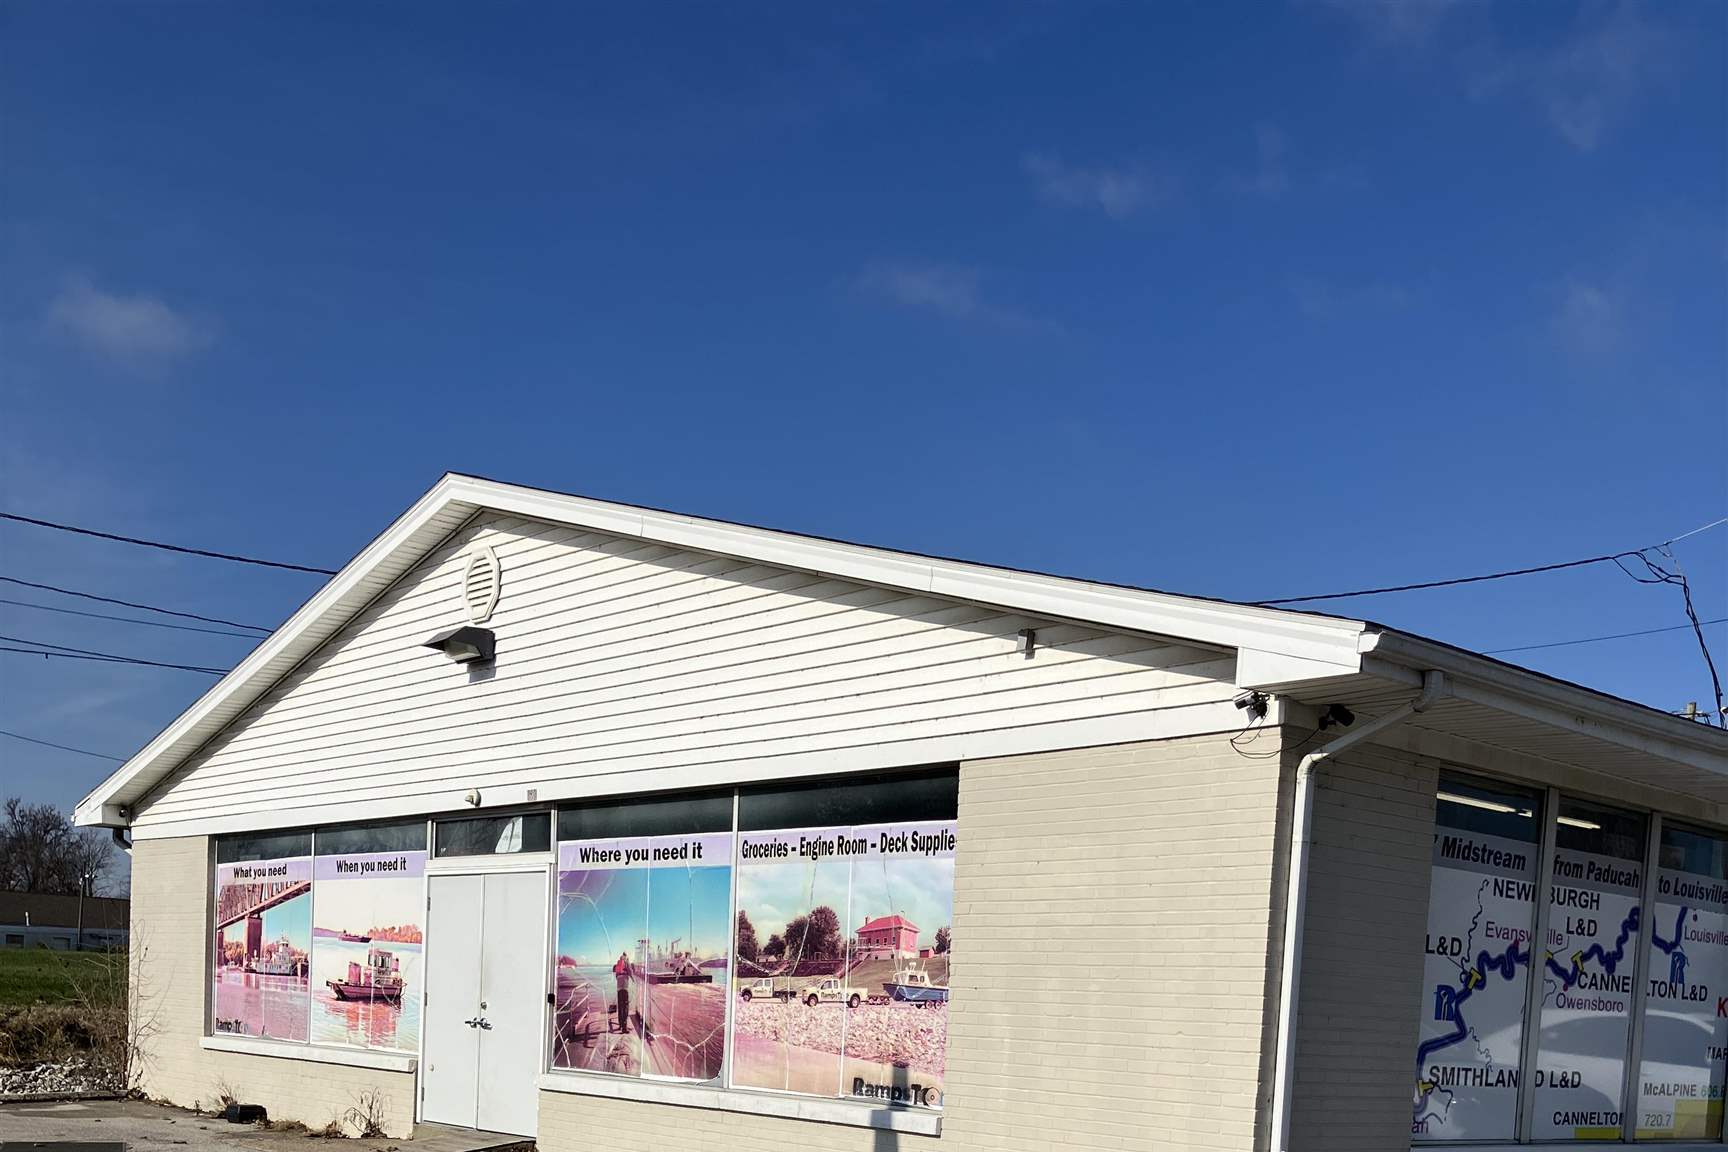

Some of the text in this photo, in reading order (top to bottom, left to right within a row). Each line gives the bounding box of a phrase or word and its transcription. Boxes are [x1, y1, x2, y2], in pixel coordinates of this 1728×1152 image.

[579, 842, 703, 866] Where you need it
[742, 837, 788, 859] Groceries
[799, 835, 834, 860] Engine
[837, 835, 867, 855] Room
[880, 831, 908, 853] Deck
[911, 828, 957, 856] Supplie
[233, 863, 287, 880] What you need
[336, 857, 407, 876] When you need it
[1441, 835, 1728, 904] Midstream from Paducah to Louisville
[1566, 916, 1598, 938] L&D
[1425, 934, 1463, 957] L&D
[1681, 982, 1708, 1002] L&D
[1555, 992, 1624, 1013] Owensboro
[1549, 1070, 1582, 1089] L&D
[1643, 1082, 1697, 1097] McALPINE
[1644, 1113, 1672, 1128] 720.7
